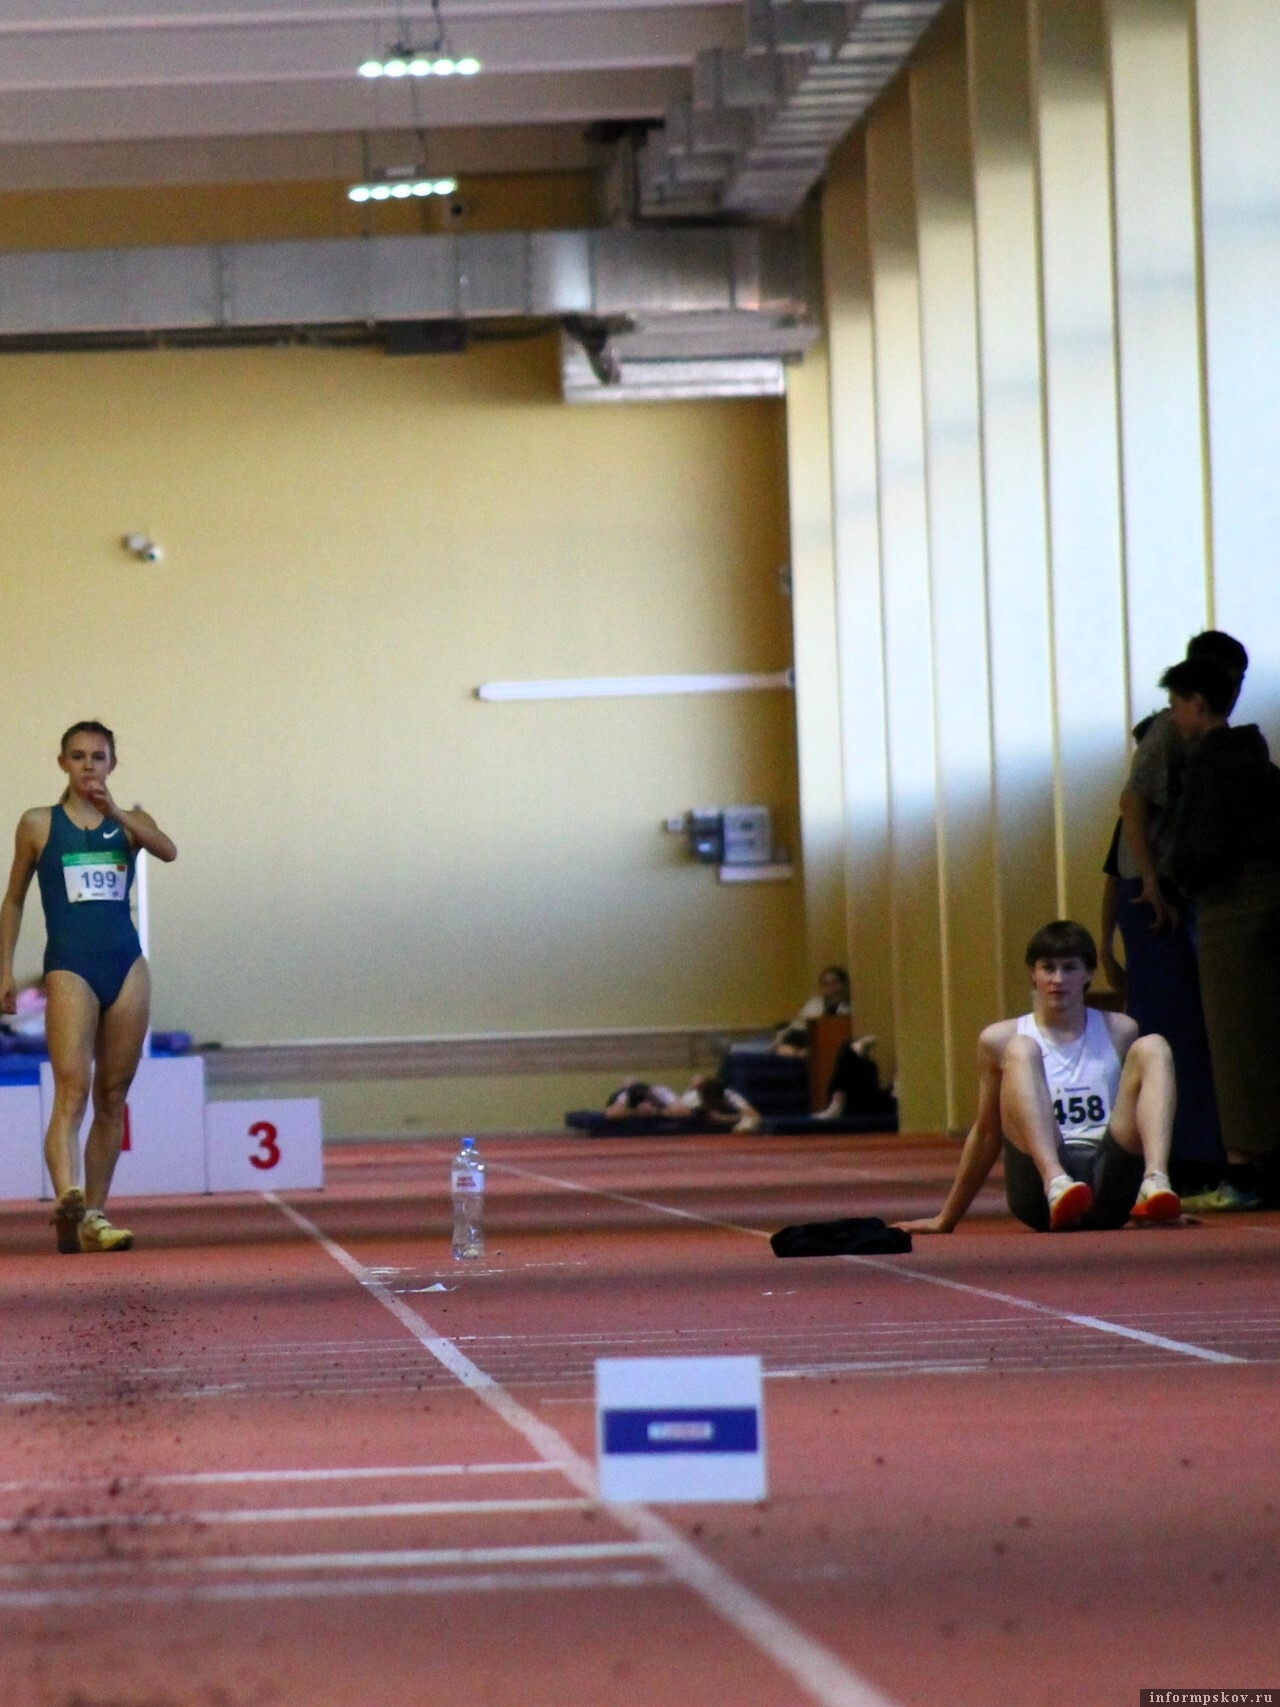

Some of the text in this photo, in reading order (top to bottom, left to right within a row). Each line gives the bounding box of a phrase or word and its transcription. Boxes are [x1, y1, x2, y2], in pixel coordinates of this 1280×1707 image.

[81, 871, 116, 889] 199
[1053, 1095, 1106, 1125] 458
[248, 1121, 281, 1170] 3
